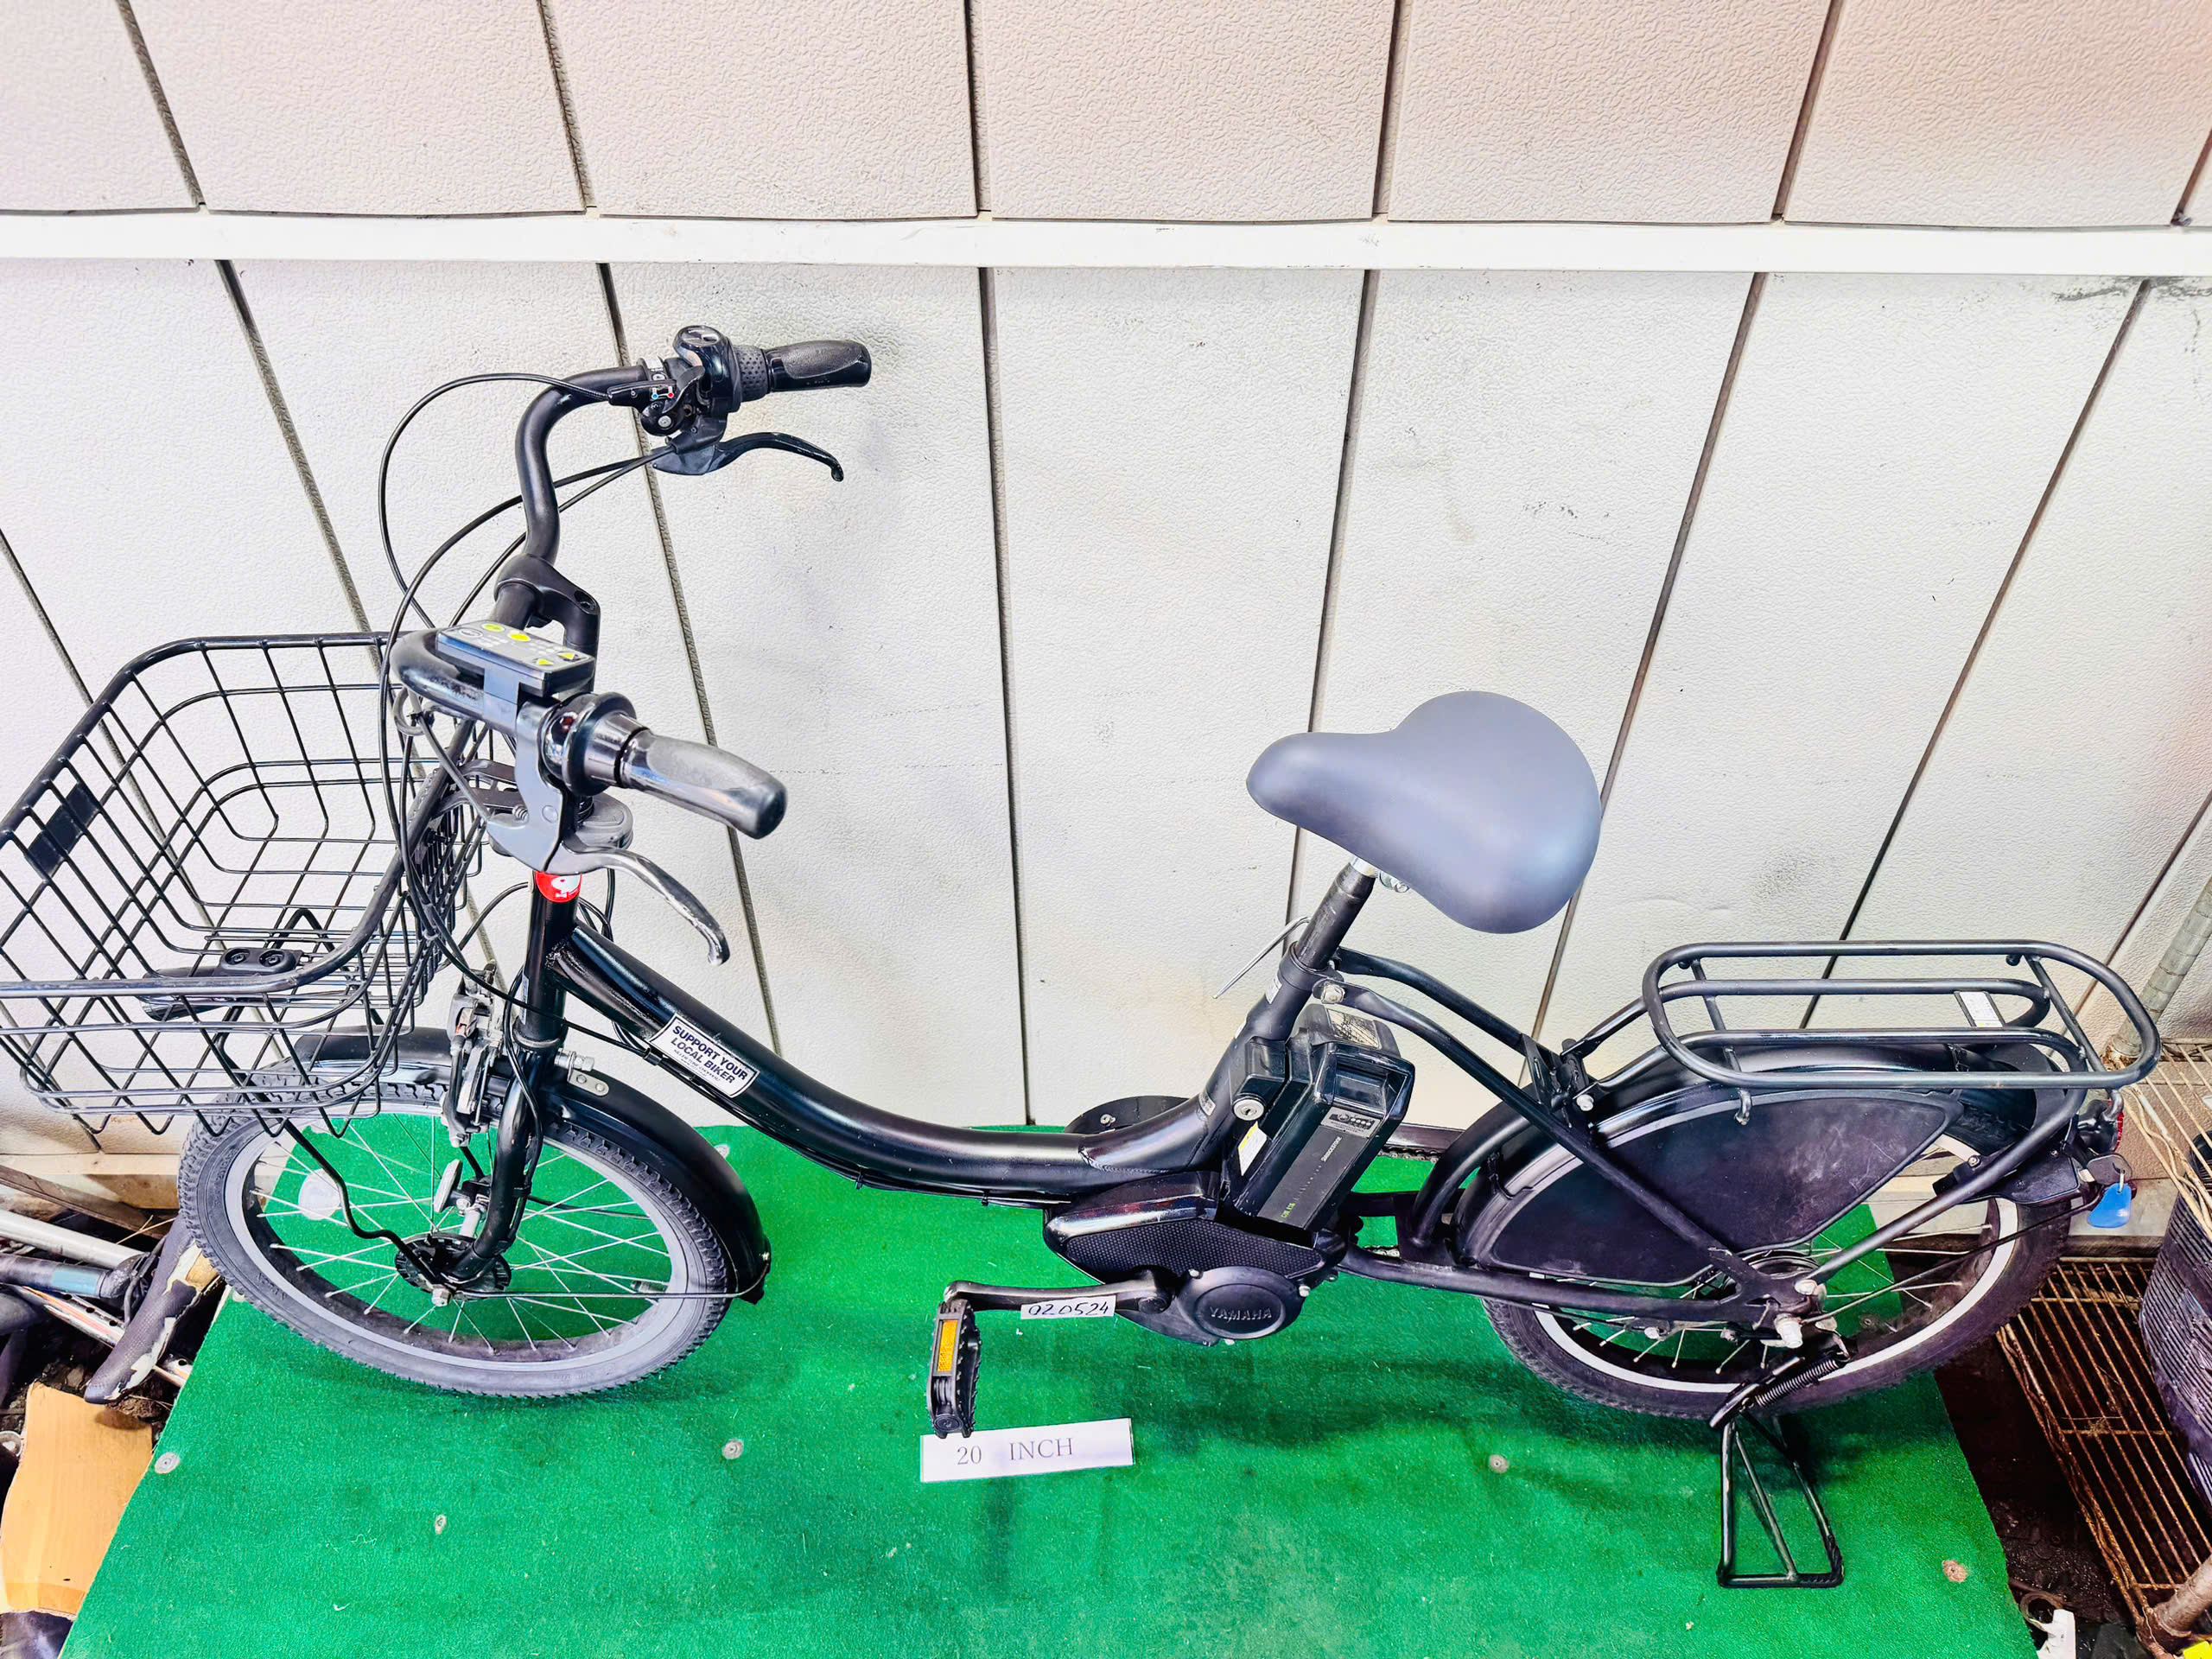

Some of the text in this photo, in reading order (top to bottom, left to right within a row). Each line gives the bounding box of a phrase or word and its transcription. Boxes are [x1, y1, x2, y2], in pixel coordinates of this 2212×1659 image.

[671, 1038, 702, 1064] LOCAL
[704, 1060, 735, 1084] BIKER
[672, 1026, 721, 1060] SUPPORT
[720, 1057, 748, 1080] YOUR
[1209, 1306, 1273, 1321] YAMAHA
[957, 1437, 1073, 1465] 20 INCH
